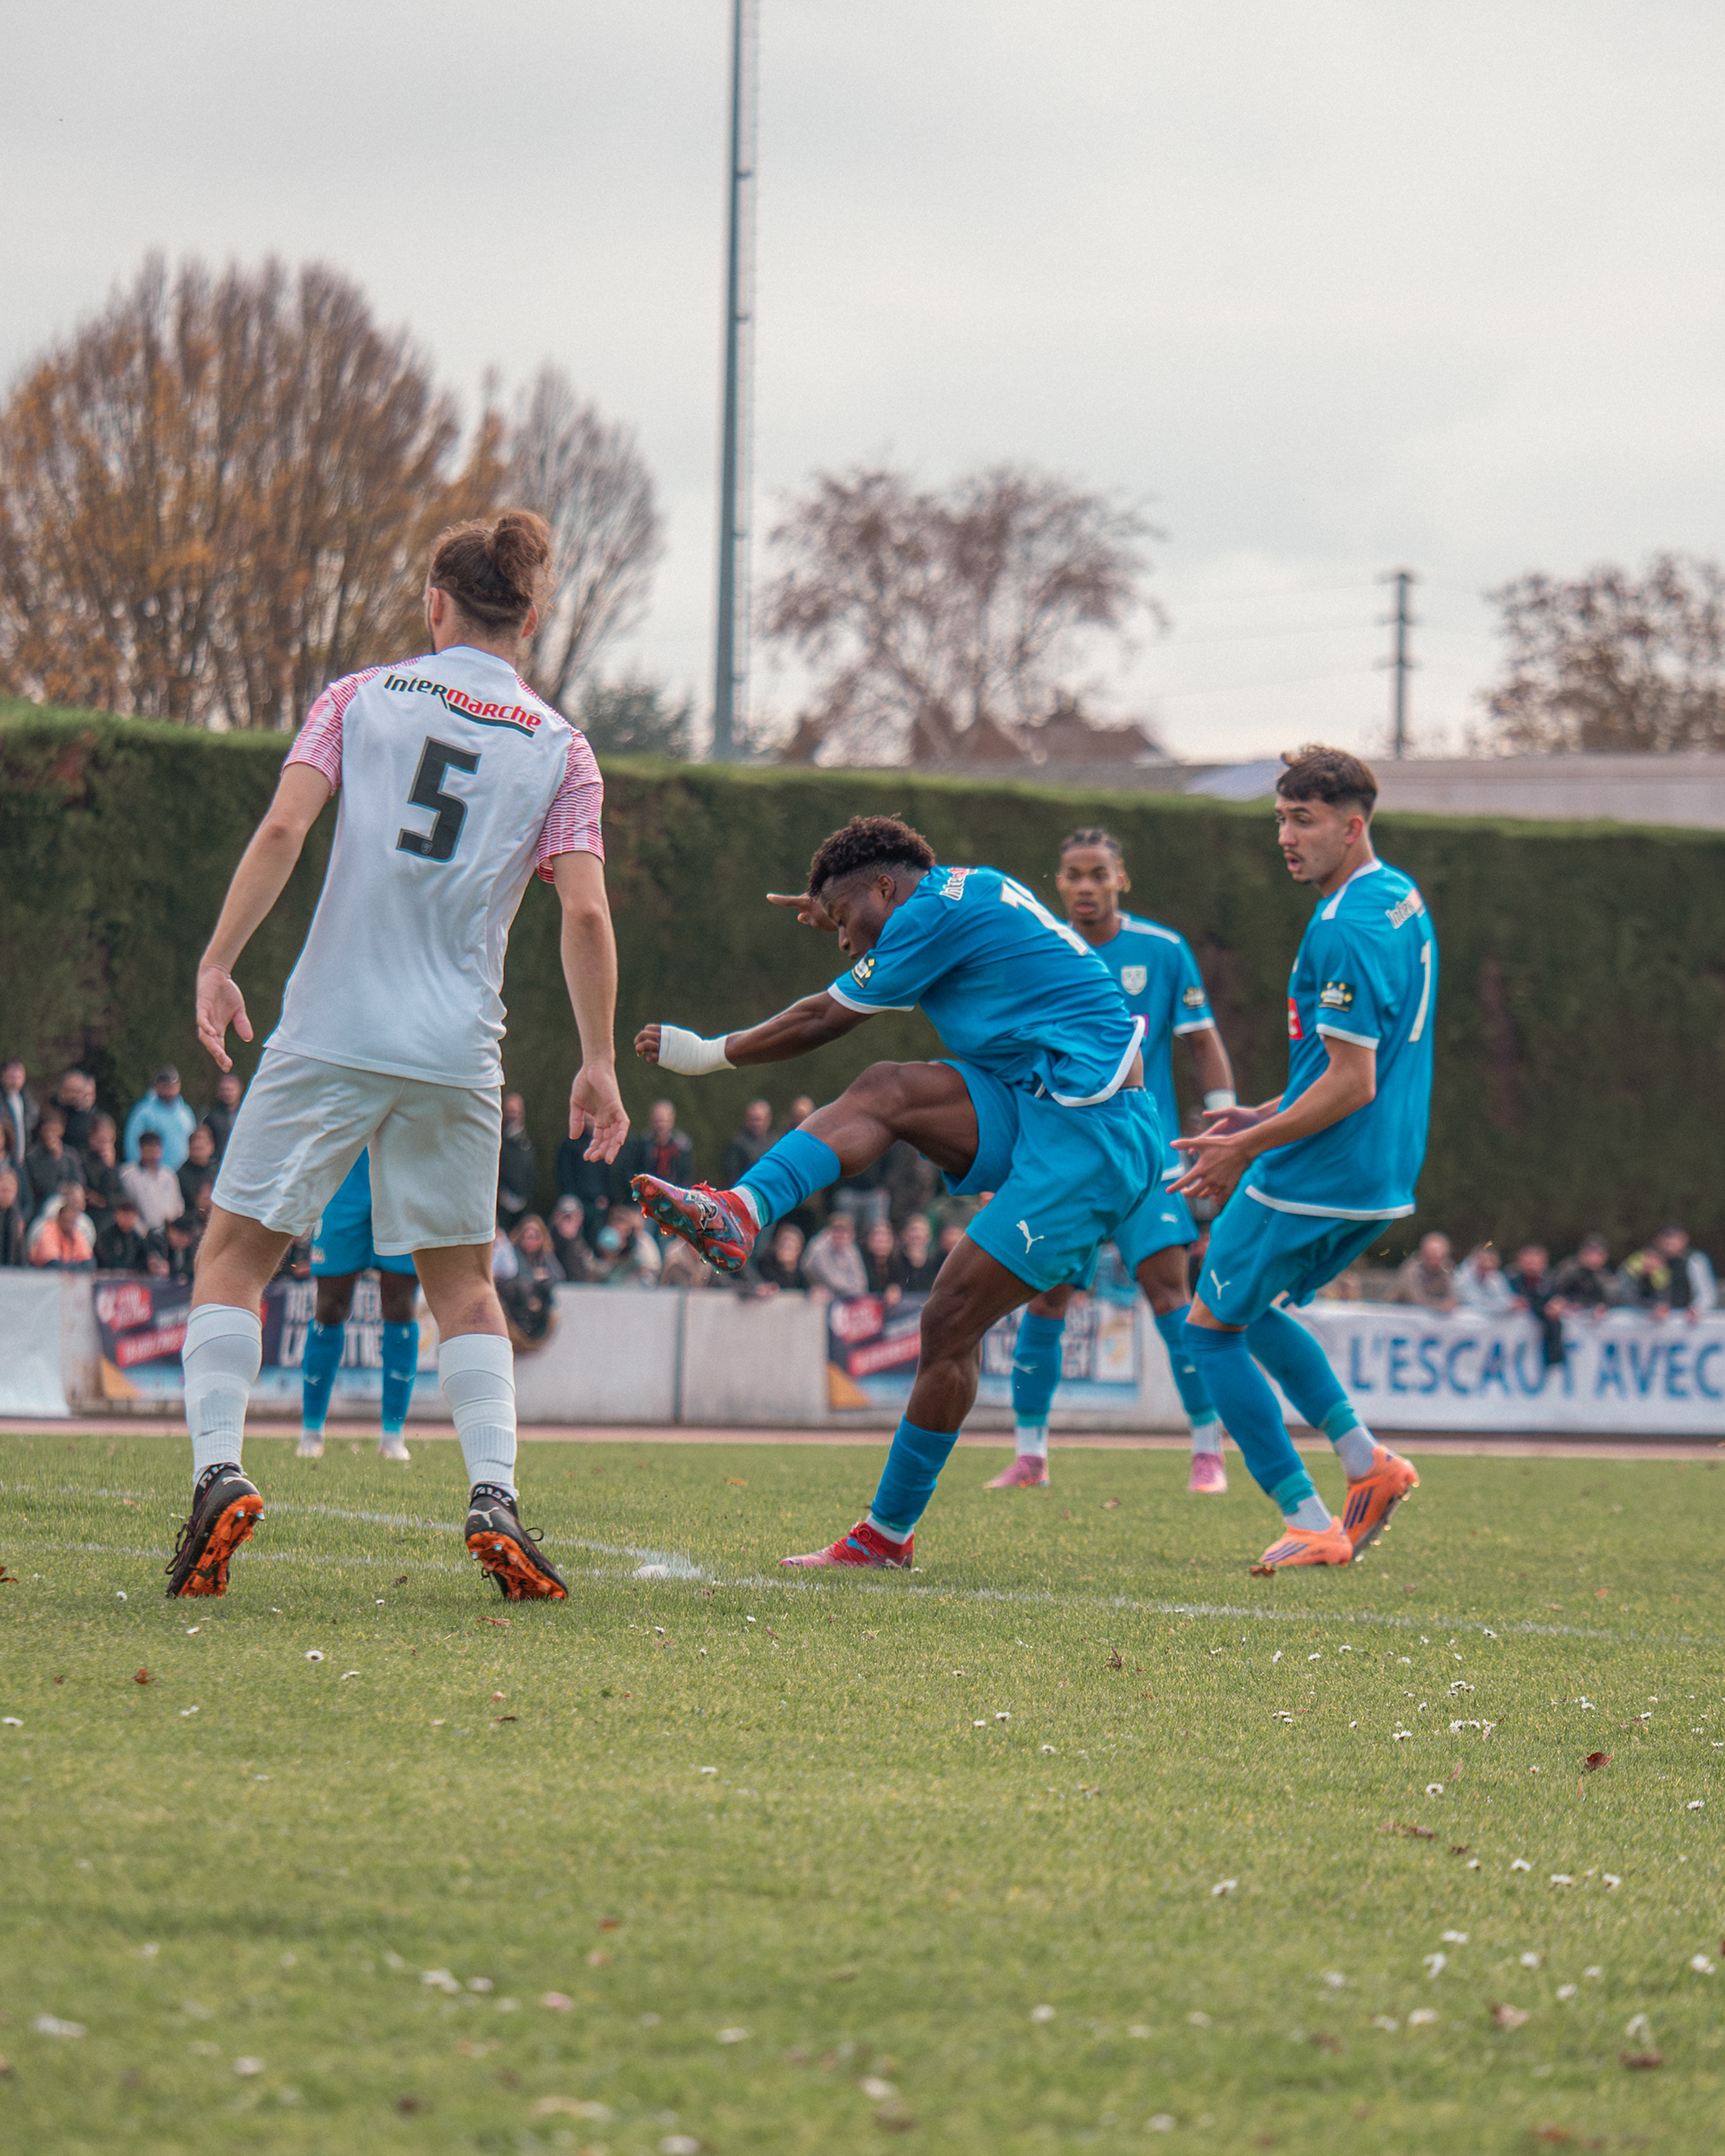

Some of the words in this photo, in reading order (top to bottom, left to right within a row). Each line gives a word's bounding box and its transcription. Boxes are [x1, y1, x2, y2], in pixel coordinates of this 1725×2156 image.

[396, 735, 482, 863] 5
[1351, 1336, 1584, 1398] L'ESCAUT
[1594, 1340, 1725, 1400] AVEC
